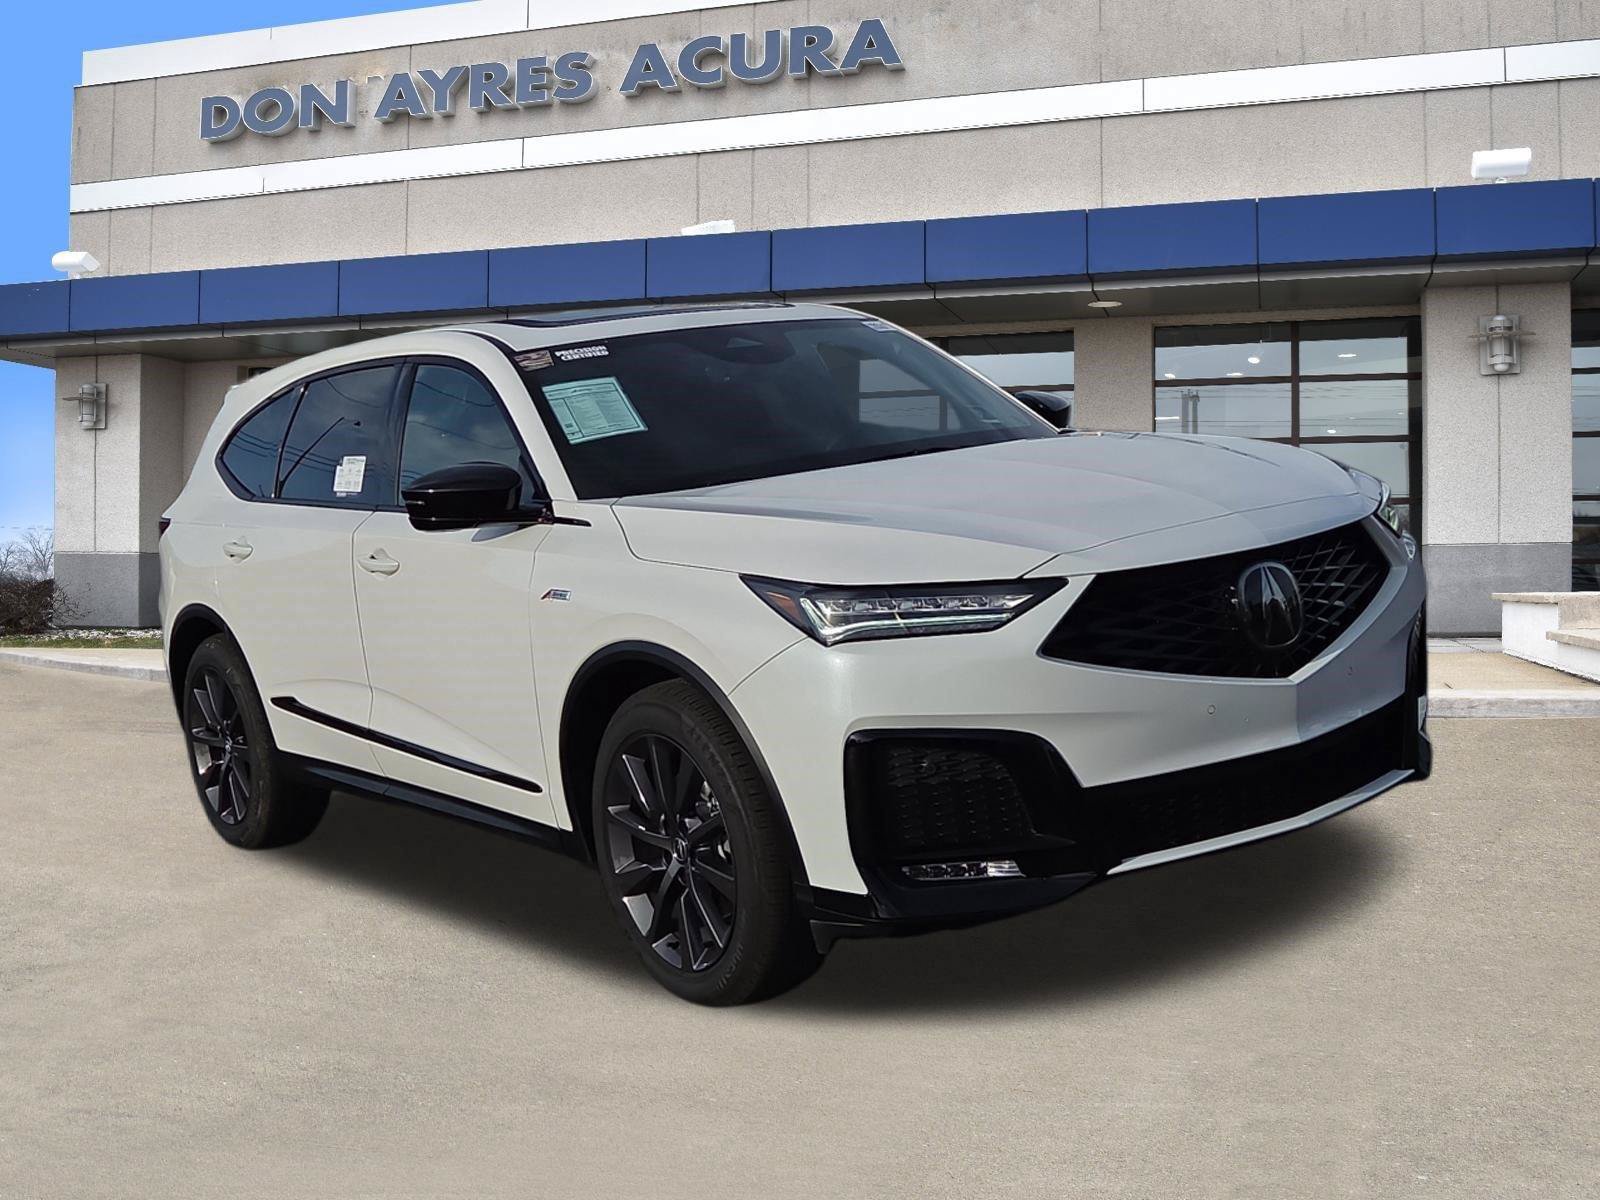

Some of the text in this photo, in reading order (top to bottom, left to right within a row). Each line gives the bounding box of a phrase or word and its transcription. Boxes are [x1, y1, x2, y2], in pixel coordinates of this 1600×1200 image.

[200, 18, 904, 143] DON AYRES ACURA
[555, 345, 607, 356] PRECISION
[561, 351, 609, 361] CERTIFIED
